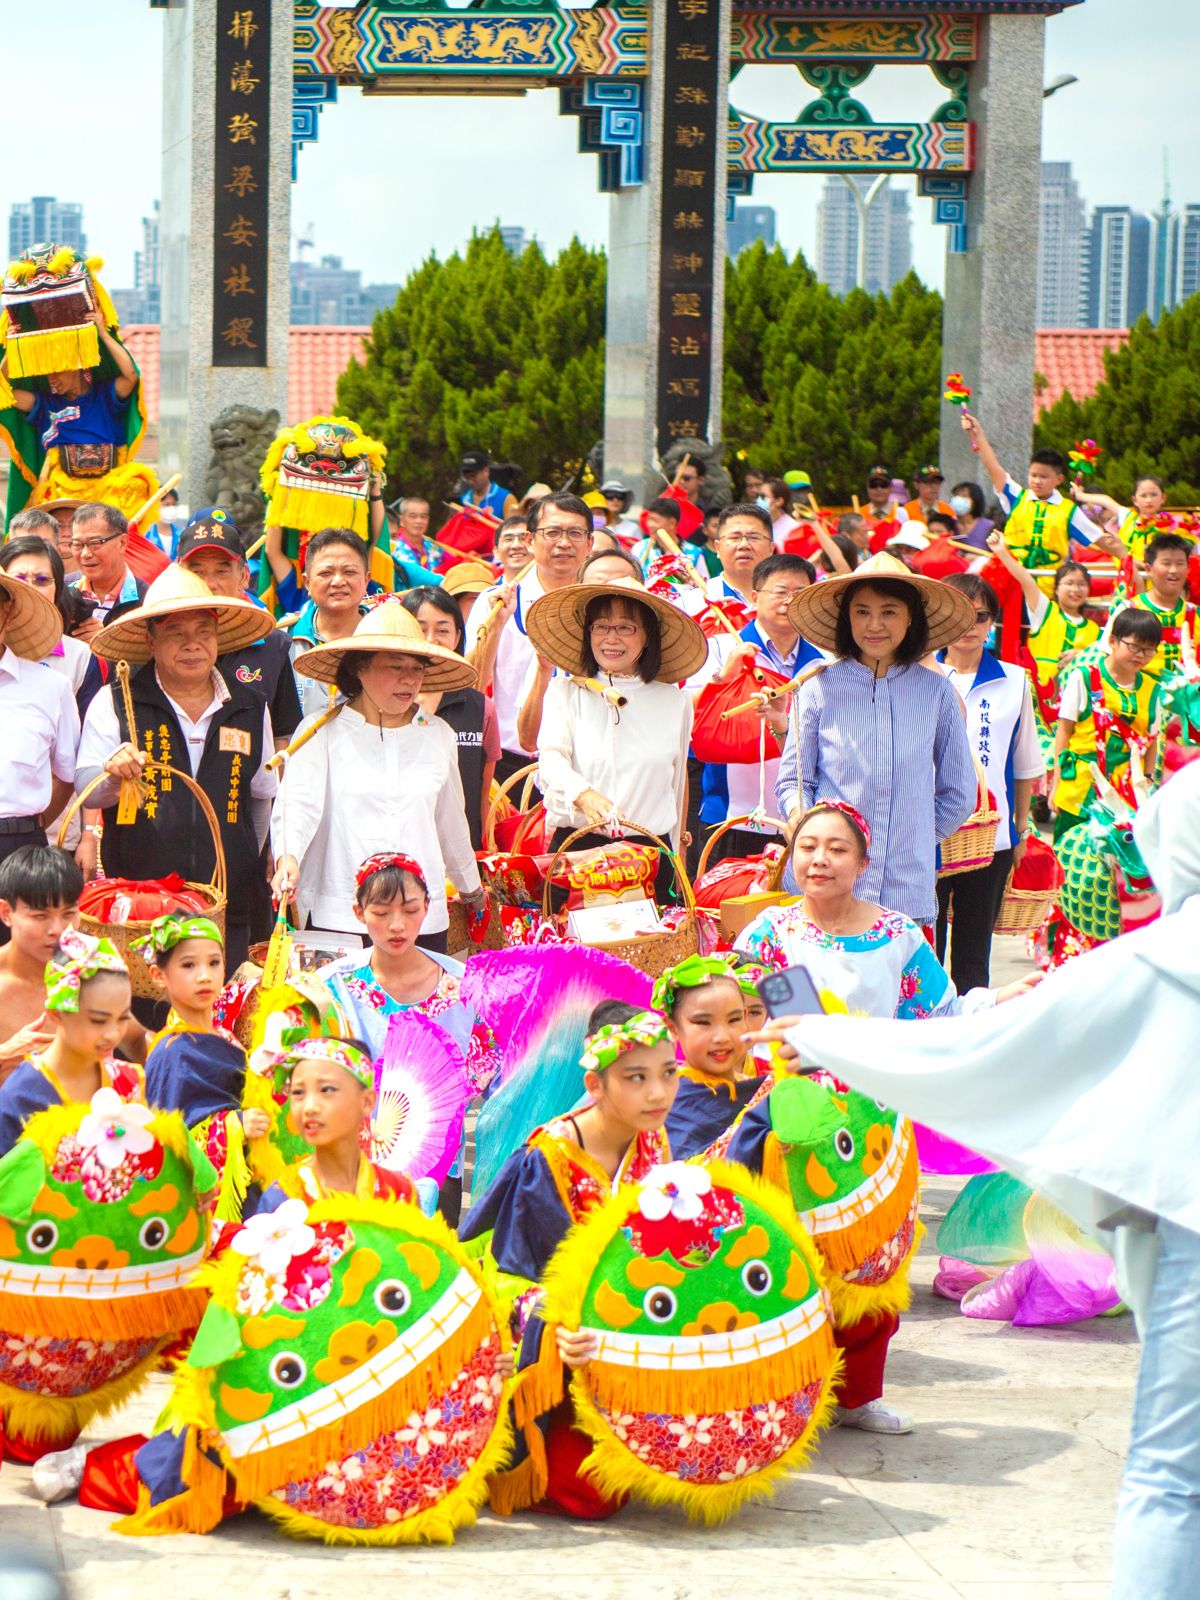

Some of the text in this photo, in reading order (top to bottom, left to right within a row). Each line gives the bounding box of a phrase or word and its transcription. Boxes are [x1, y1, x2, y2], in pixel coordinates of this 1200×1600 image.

[220, 10, 261, 350] 掃蕩強梁安社稷
[979, 698, 991, 767] 南投縣政府
